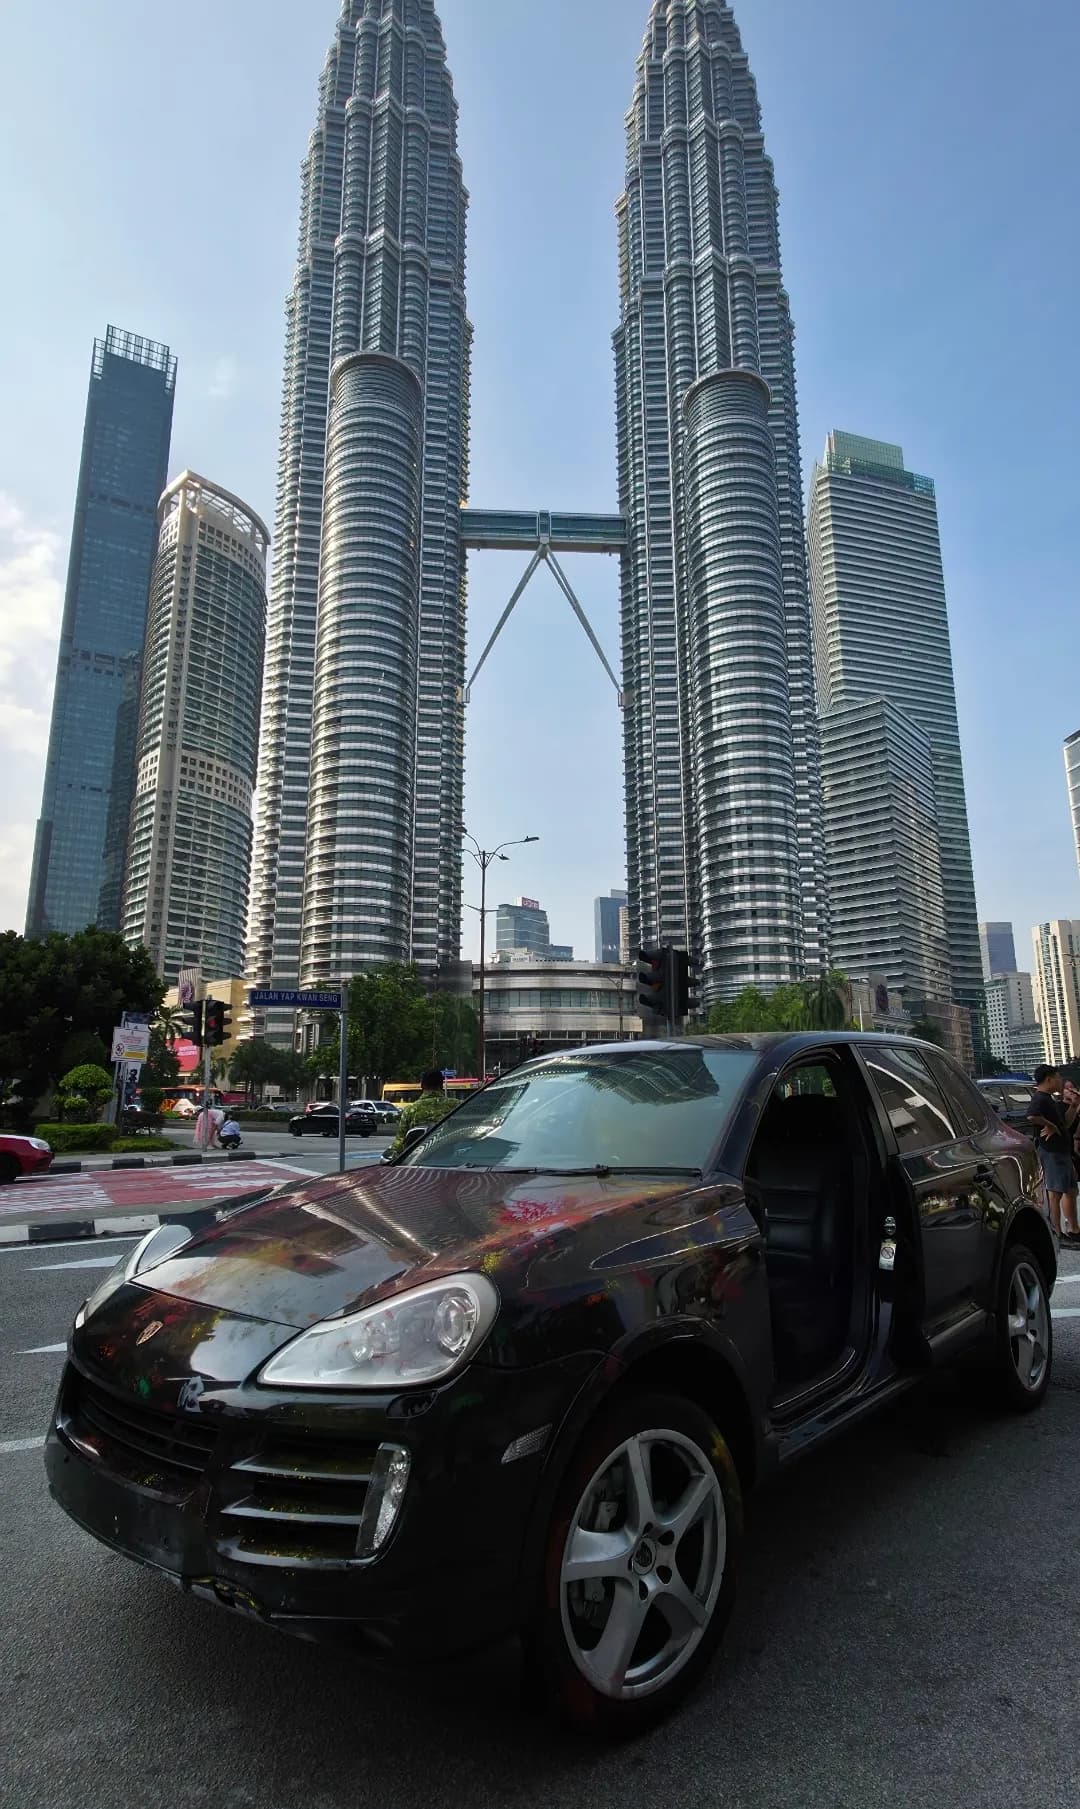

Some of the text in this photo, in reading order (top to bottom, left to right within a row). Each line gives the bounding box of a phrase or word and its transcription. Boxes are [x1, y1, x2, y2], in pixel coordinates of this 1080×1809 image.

[255, 991, 338, 1003] JALAN YAP KWAN SENG
